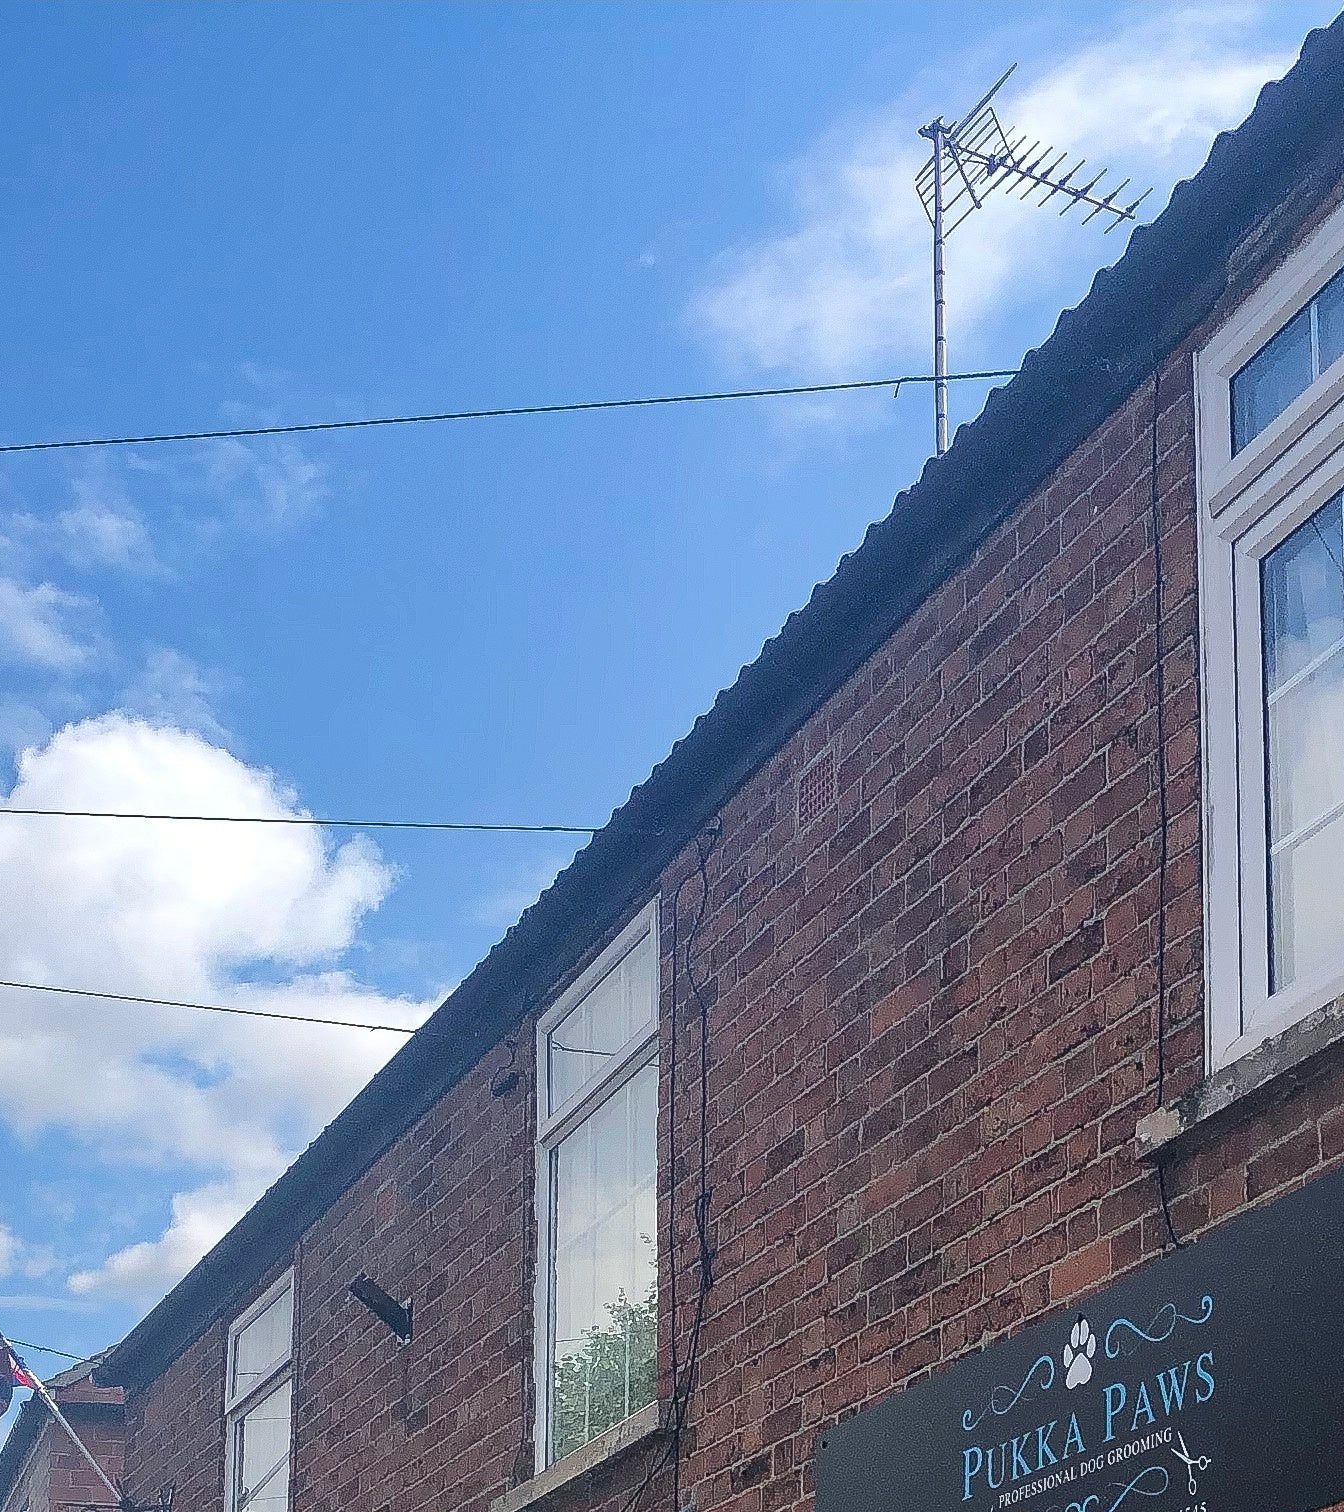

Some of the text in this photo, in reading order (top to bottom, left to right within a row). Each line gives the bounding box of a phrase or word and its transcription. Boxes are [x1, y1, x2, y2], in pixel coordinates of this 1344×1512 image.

[962, 1351, 1214, 1501] PUKKA PAWS
[998, 1427, 1172, 1508] PROFESSIONAL DOG GROOMING
